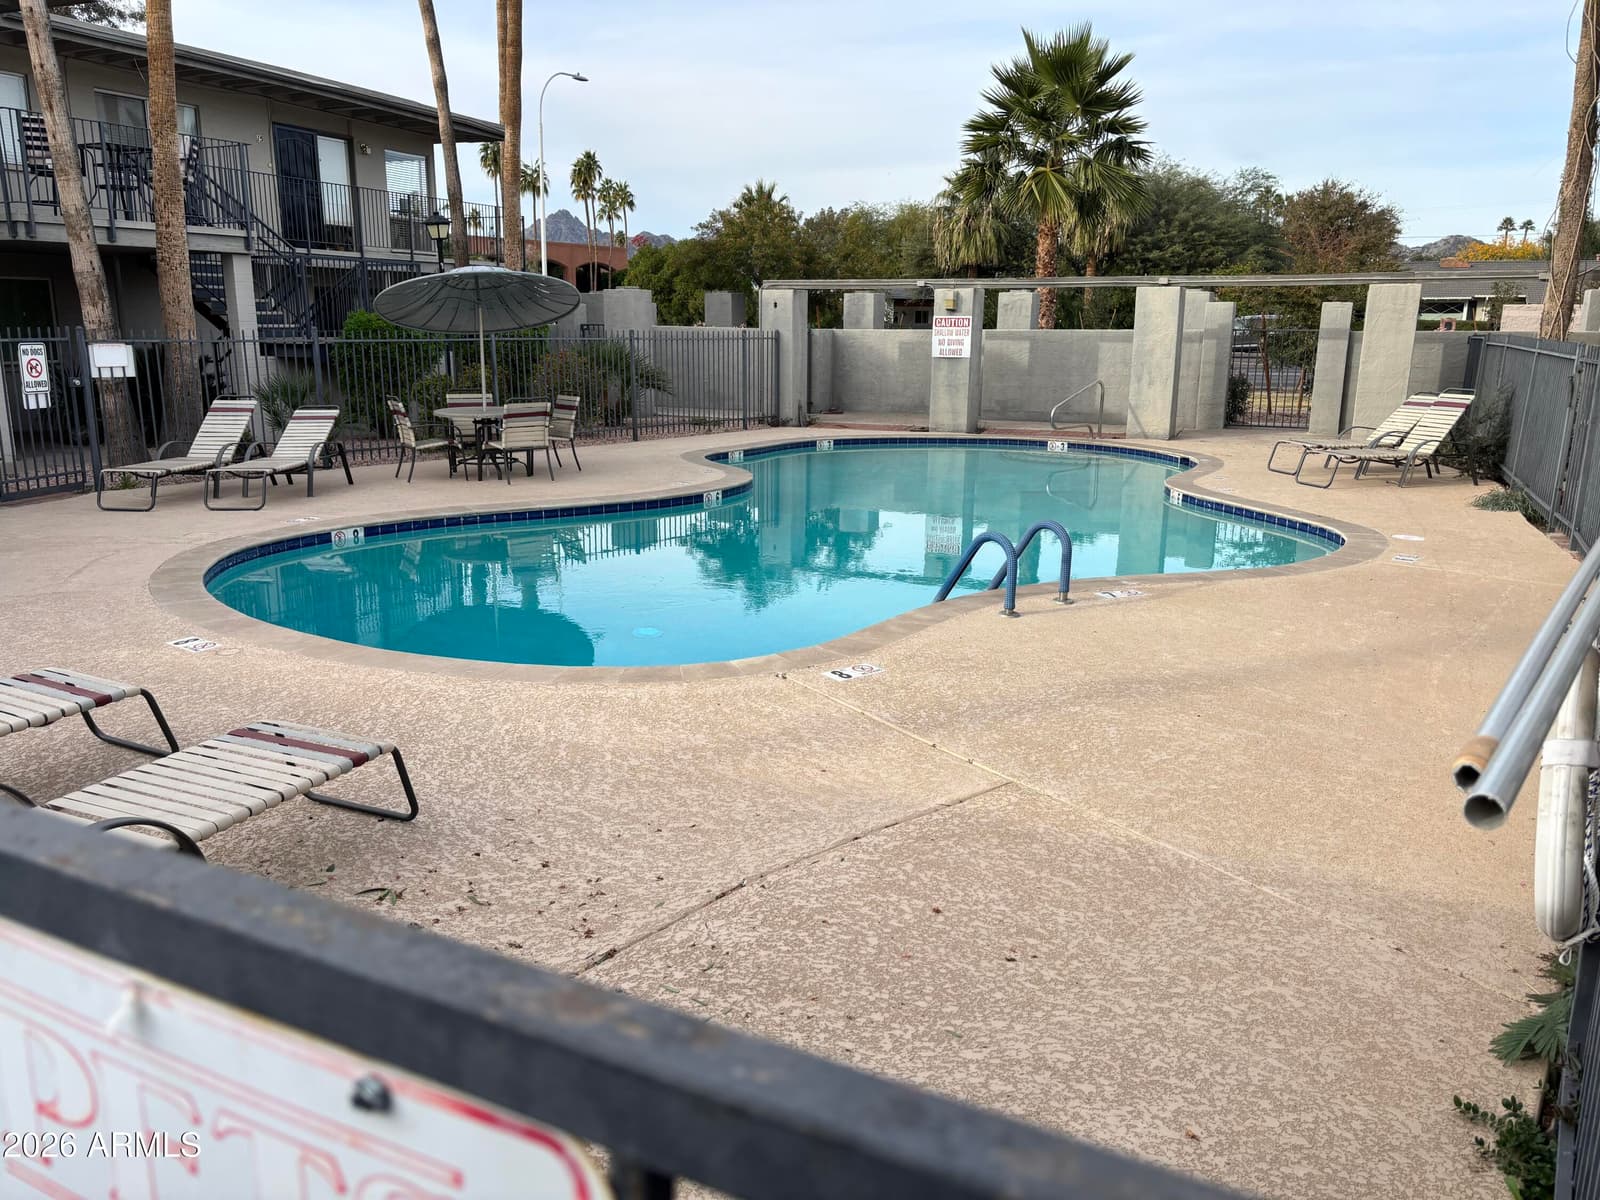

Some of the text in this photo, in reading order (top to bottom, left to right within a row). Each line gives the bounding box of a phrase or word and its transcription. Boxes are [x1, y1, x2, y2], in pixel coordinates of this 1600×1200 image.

[935, 318, 969, 327] CAUTION
[955, 328, 970, 337] WATER
[938, 338, 965, 346] NO DIVING
[22, 347, 43, 356] NO DOGS
[939, 347, 963, 356] ALLOWED
[25, 380, 48, 389] ALLOWED
[352, 529, 360, 545] 8
[830, 670, 852, 679] 8
